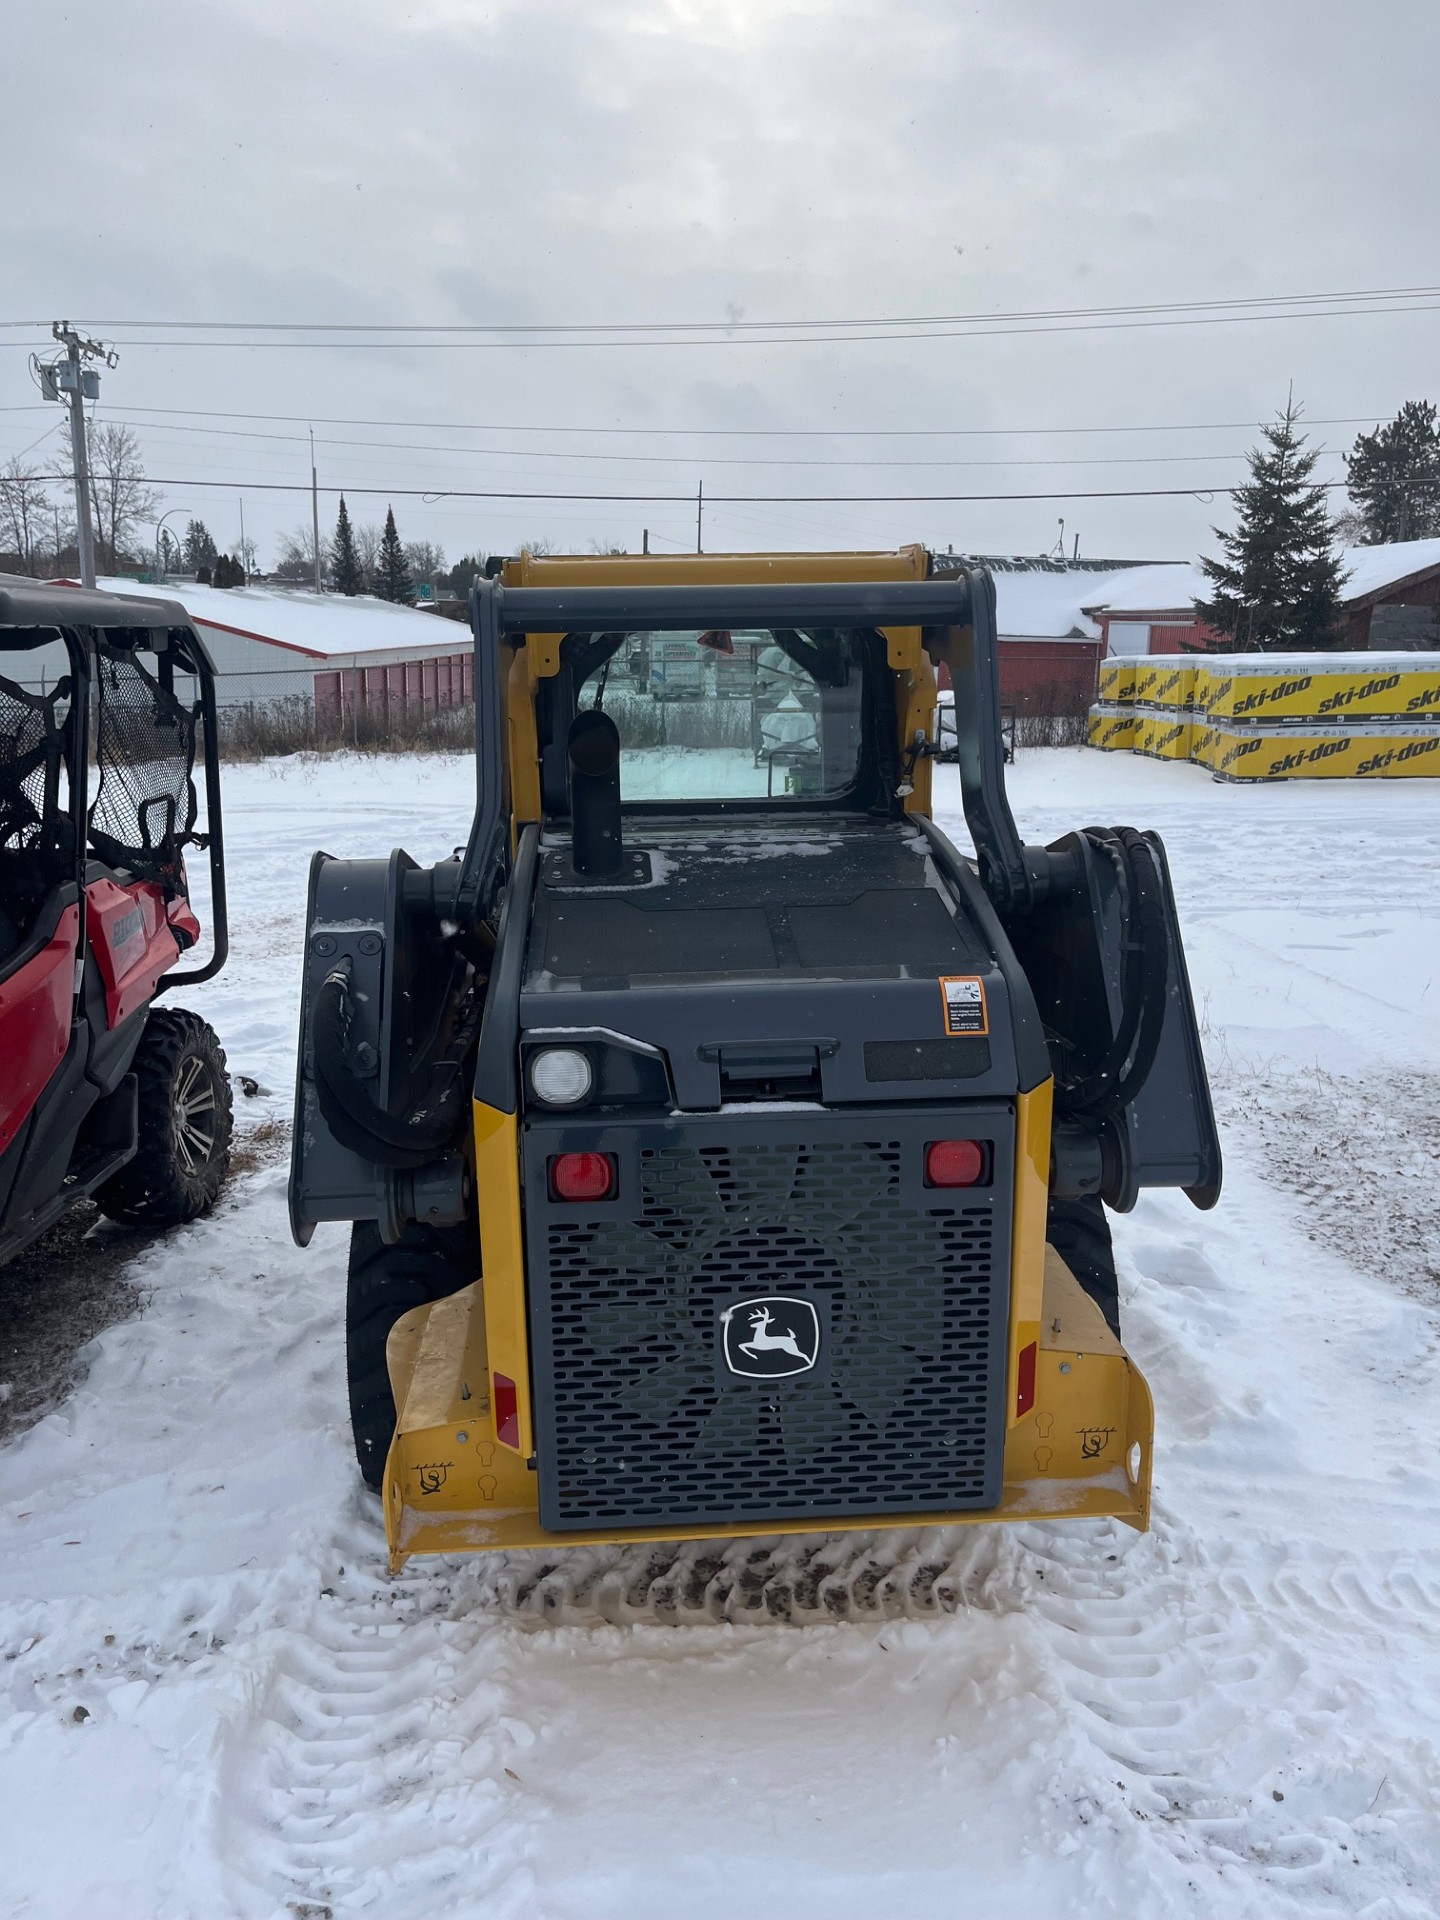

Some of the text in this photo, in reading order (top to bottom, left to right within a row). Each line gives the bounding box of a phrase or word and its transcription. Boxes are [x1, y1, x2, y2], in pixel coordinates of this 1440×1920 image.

[1233, 675, 1313, 715] ski-doo
[1318, 673, 1400, 713] ski-doo
[1268, 738, 1351, 776] ski-doo
[1355, 737, 1440, 776] ski-doo
